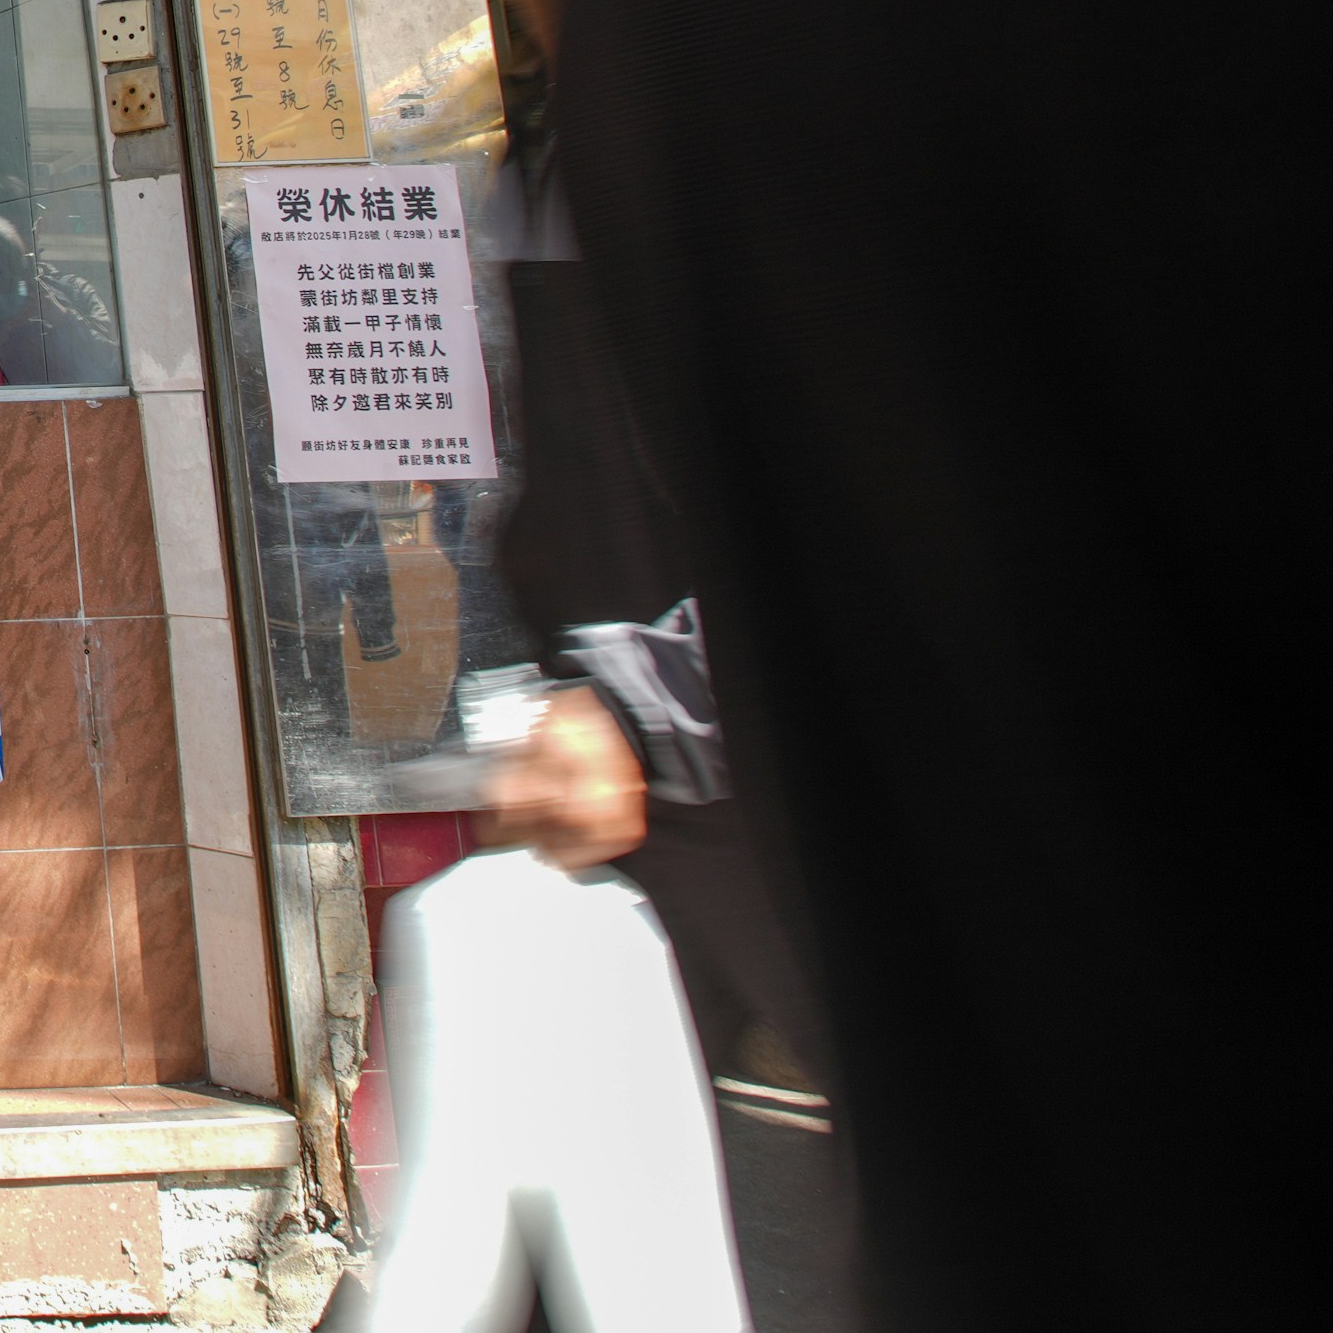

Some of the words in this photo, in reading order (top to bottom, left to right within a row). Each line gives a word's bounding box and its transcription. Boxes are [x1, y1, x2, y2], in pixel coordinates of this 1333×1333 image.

[276, 186, 438, 223] 榮休結業
[297, 262, 436, 281] 先父從街檔創業
[299, 287, 439, 307] 蒙街坊鄰里支持
[302, 314, 443, 333] 滿載一甲子情懷
[305, 339, 446, 359] 無奈歲月不饒人
[308, 366, 450, 386] 聚有時散亦有時
[310, 392, 453, 412] 除夕邀君來笑別
[301, 438, 411, 452] 願街坊好友身體安康
[421, 437, 470, 450] 珍重再見
